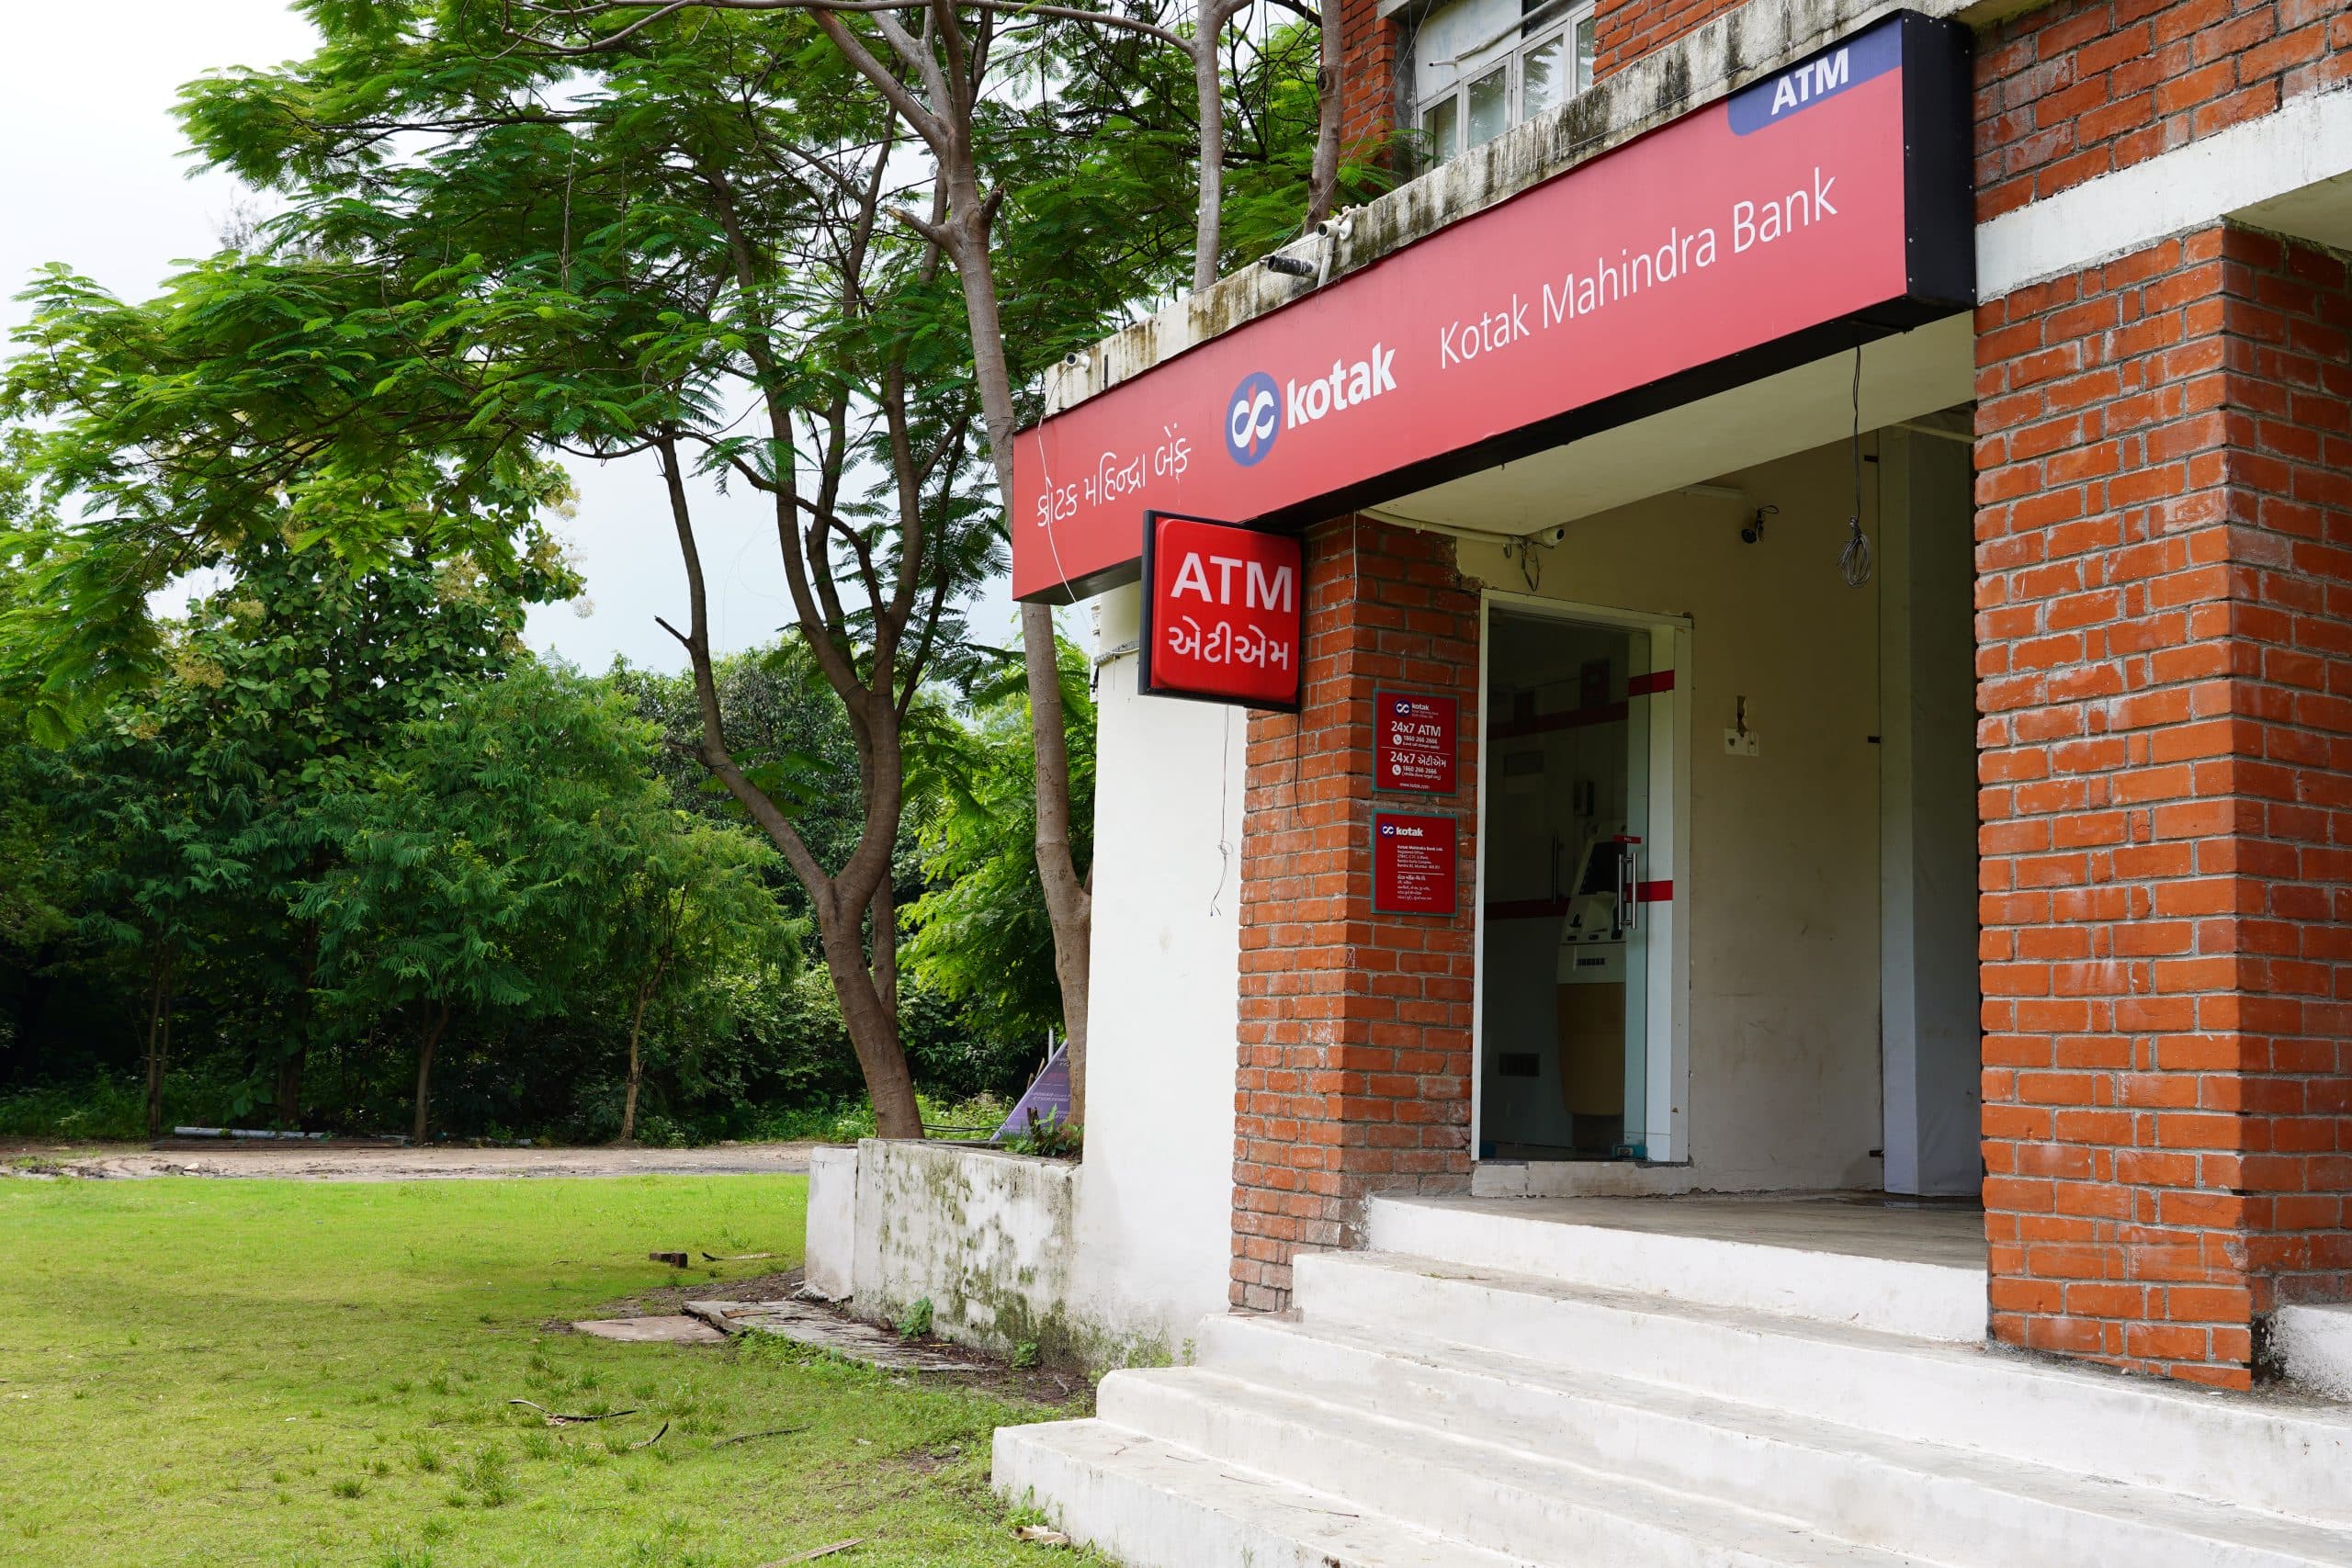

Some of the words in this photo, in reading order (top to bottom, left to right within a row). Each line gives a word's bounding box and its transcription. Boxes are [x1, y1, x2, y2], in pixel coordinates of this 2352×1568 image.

[1770, 48, 1849, 116] ATM
[1441, 293, 1530, 369] Kotak
[1543, 227, 1716, 329] Mahindra
[1733, 166, 1838, 254] Bank
[1286, 342, 1396, 430] kotak
[1037, 477, 1078, 527] કોટક
[1084, 452, 1146, 506] મહિન્દ્રા
[1170, 551, 1292, 613] ATM
[1168, 615, 1288, 671] એટીએમ
[1391, 721, 1415, 733] 24x7
[1418, 724, 1442, 738] ATM
[1412, 703, 1430, 711] kotak
[1390, 751, 1415, 763] 24x7
[1418, 754, 1447, 768] એટીએમ
[1396, 827, 1423, 837] kotak
